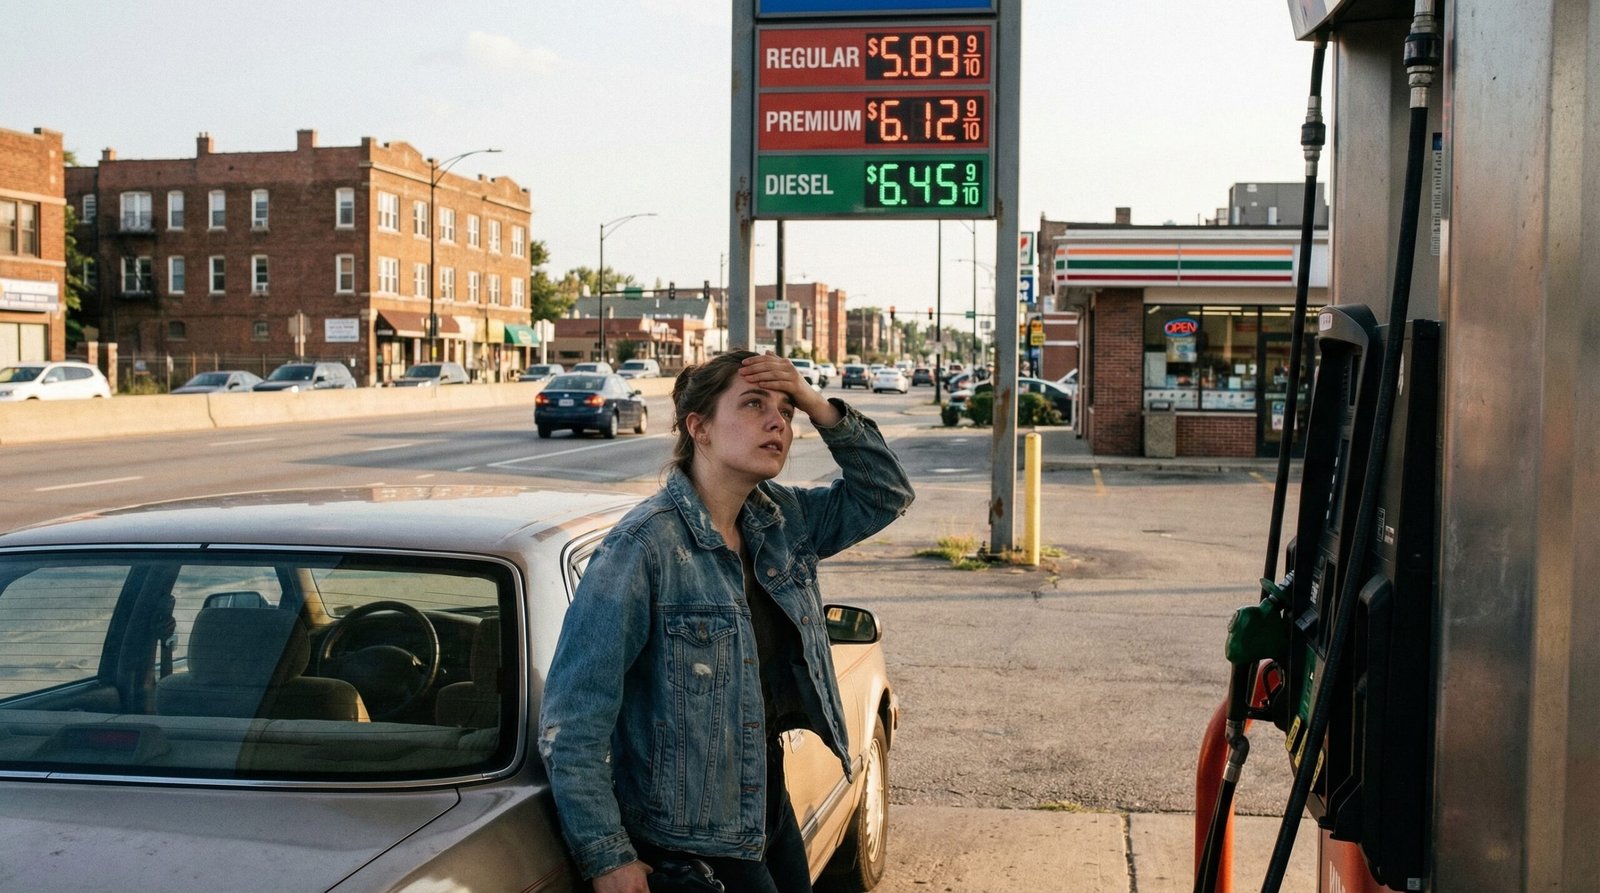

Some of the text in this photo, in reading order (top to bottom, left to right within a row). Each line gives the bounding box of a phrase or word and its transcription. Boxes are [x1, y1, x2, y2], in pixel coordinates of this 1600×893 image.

[766, 47, 860, 69] REGULAR
[868, 35, 959, 77] $5.89
[766, 110, 862, 132] PREMIUM
[867, 99, 958, 141] $6.12
[765, 174, 834, 195] DIESEL
[866, 163, 958, 206] $6.45
[1165, 321, 1197, 333] OPEN
